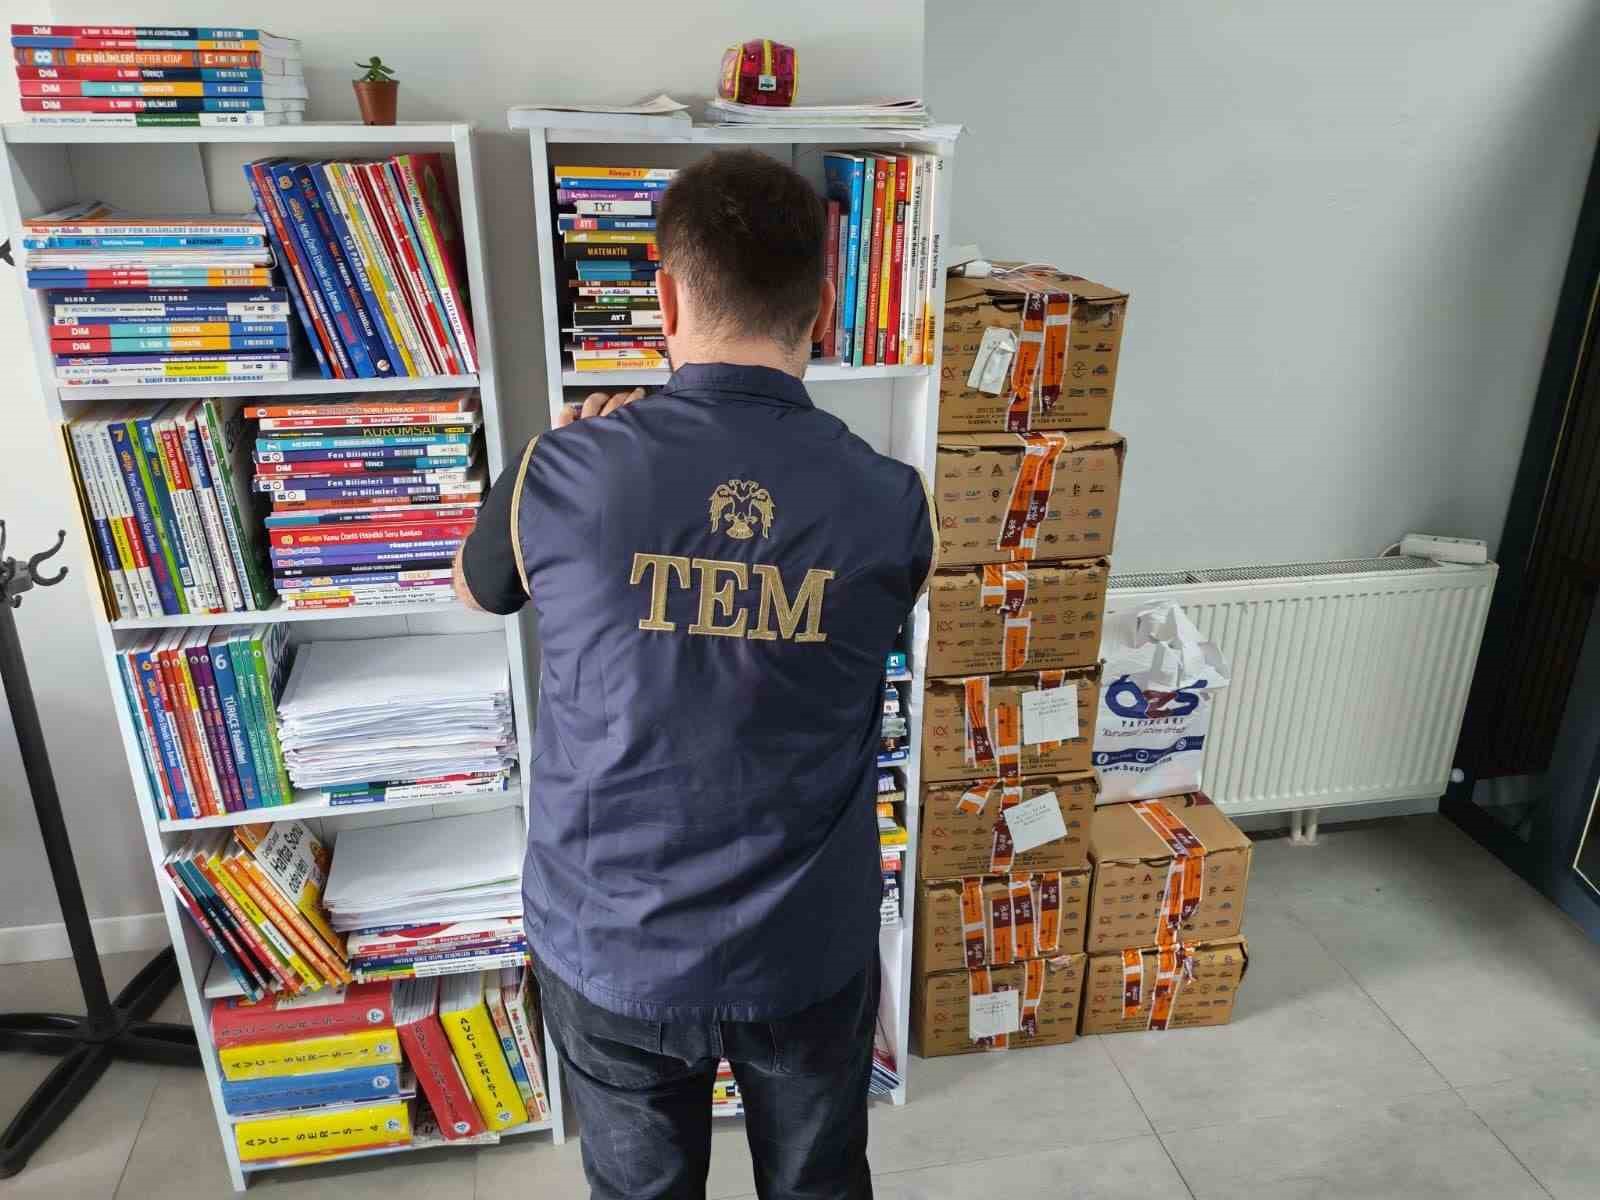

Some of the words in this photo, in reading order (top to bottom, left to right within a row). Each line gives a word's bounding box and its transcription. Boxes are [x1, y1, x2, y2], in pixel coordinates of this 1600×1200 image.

[593, 203, 613, 212] TYT
[630, 552, 835, 643] TEM
[215, 654, 227, 670] 6
[221, 694, 241, 729] TÜRKÇE
